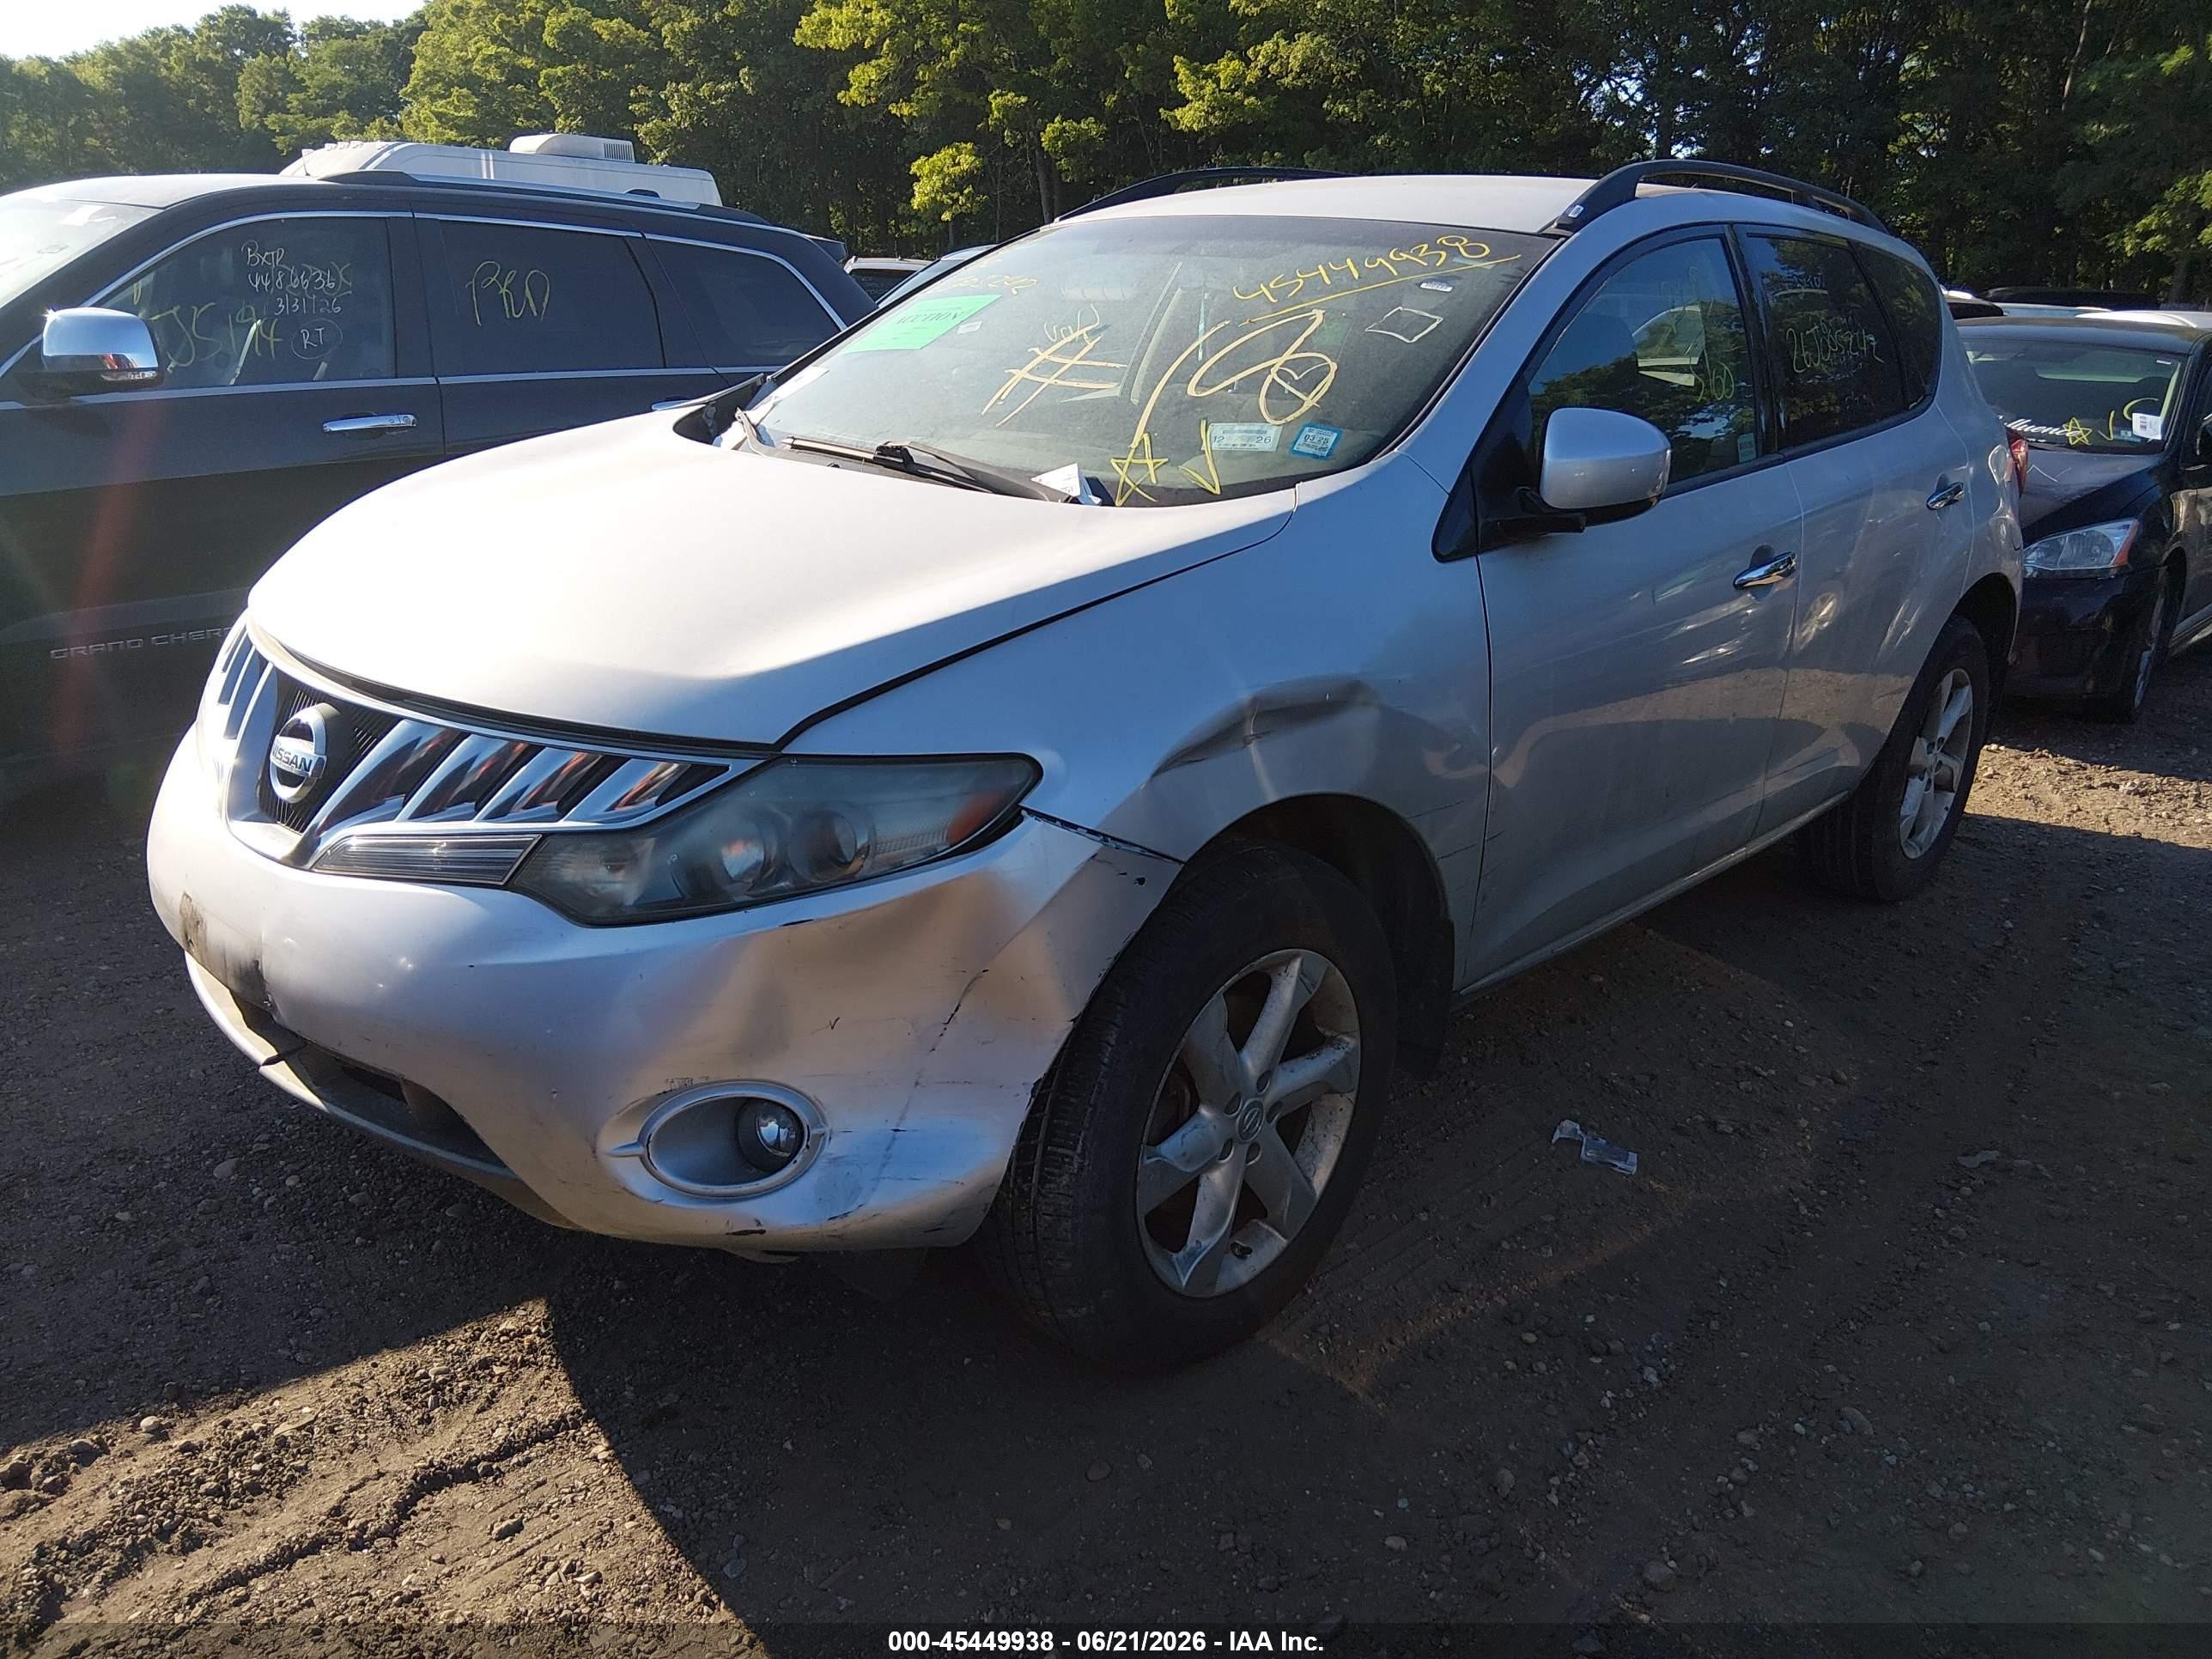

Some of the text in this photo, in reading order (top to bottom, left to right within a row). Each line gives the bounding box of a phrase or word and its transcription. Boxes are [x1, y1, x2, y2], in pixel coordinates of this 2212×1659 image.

[1233, 235, 1490, 302] 45449938
[1255, 435, 1272, 444] 26
[1304, 433, 1316, 442] 03
[50, 638, 144, 660] GRAND
[270, 741, 313, 773] NISSAN
